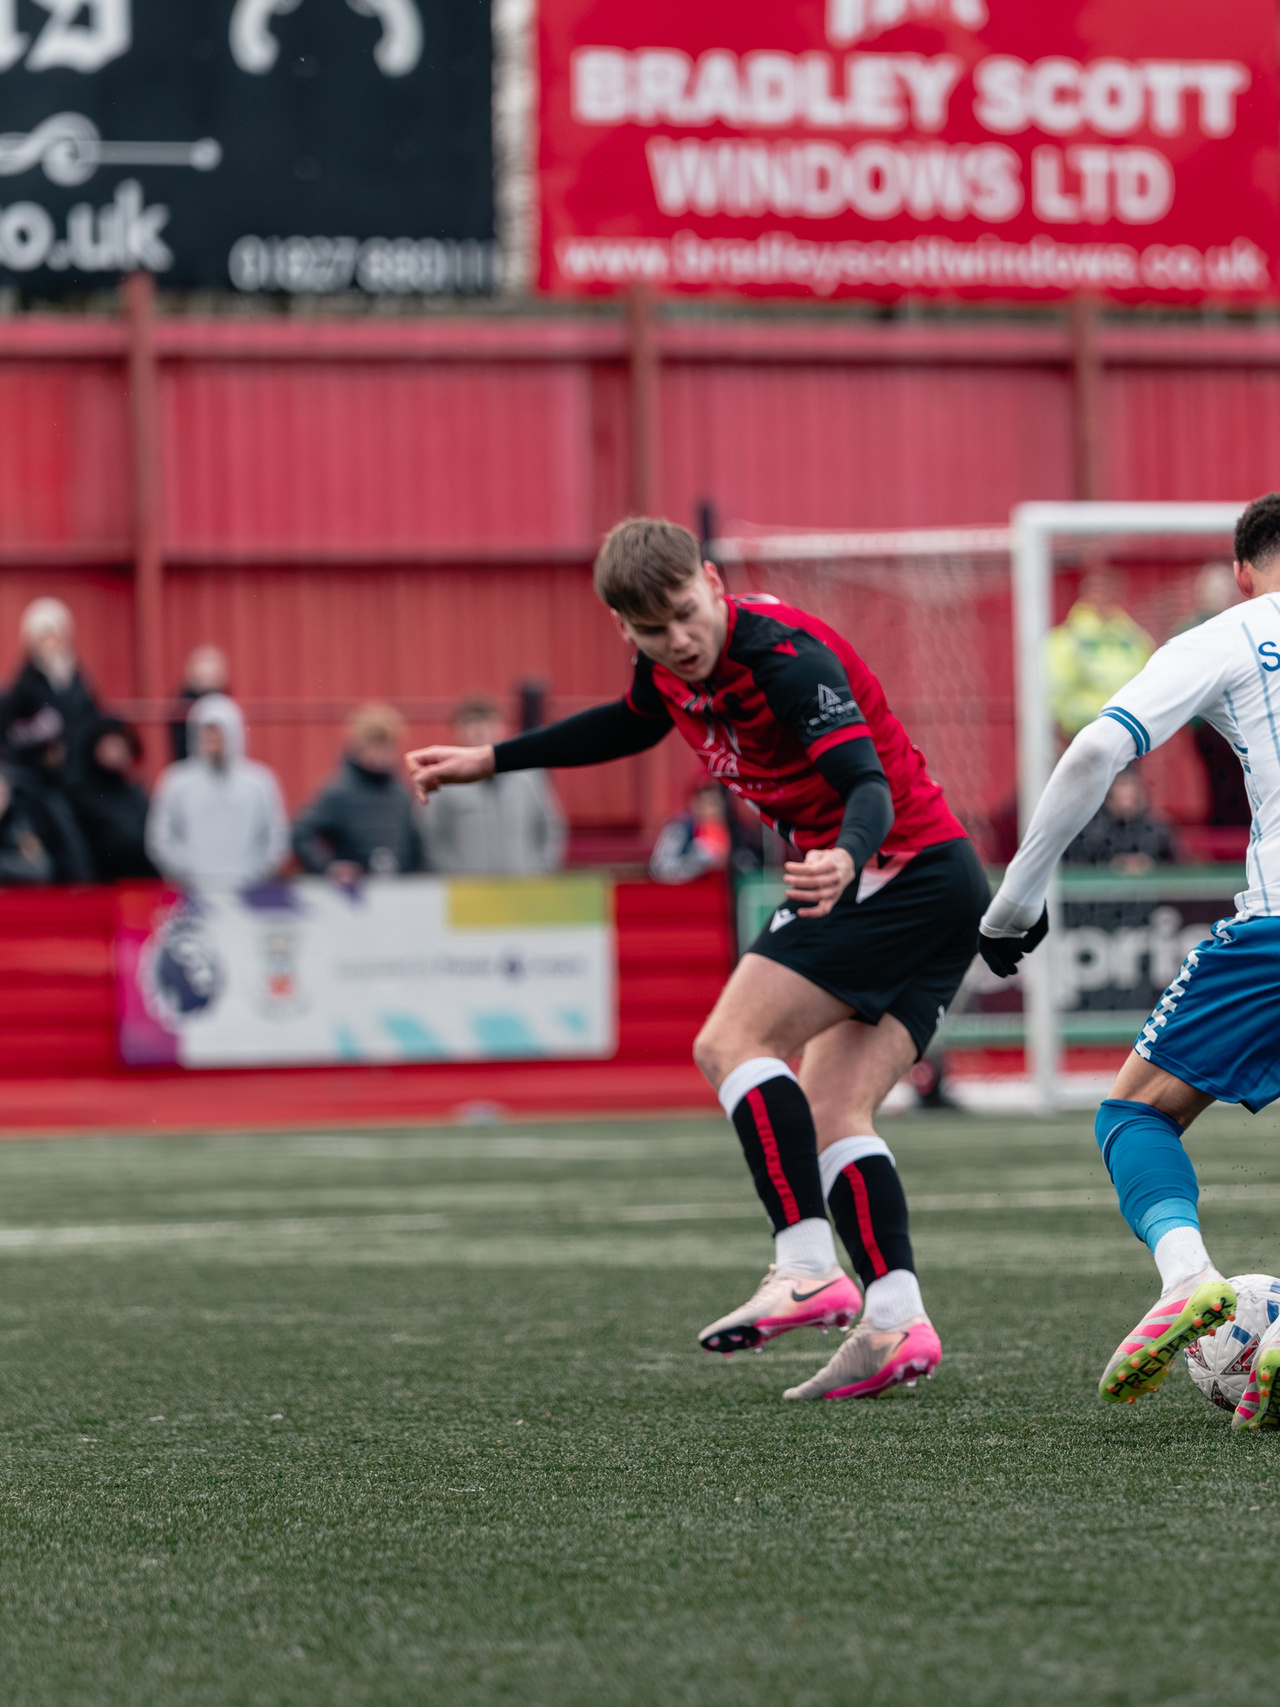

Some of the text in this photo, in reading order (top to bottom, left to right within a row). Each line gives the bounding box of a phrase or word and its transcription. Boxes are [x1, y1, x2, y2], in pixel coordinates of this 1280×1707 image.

[571, 45, 1251, 138] BRADLEY SCOTT
[646, 135, 1175, 225] WINDOWS LTD
